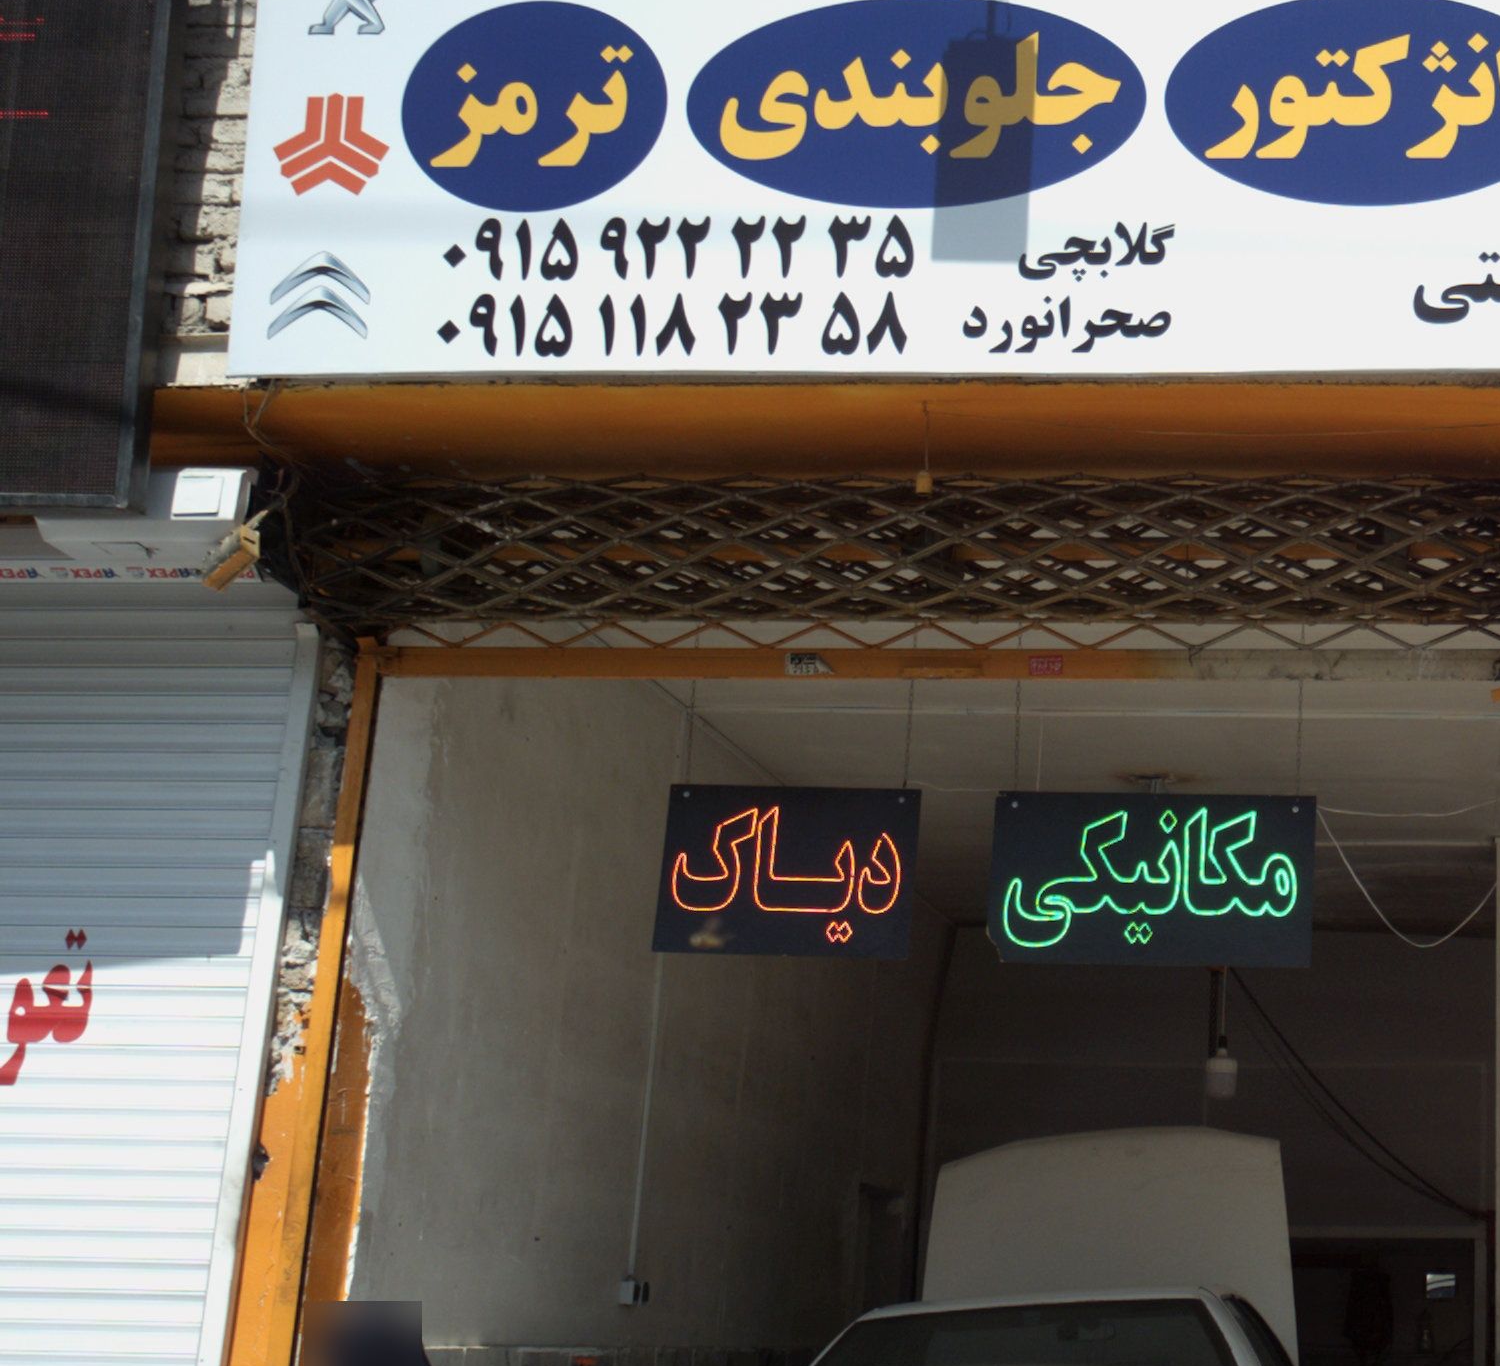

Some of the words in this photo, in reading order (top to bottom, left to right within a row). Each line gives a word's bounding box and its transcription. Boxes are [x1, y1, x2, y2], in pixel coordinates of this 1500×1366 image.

[431, 46, 633, 167] ترمز
[720, 32, 1122, 161] جلوبندی
[443, 218, 578, 280] ۰۹۱۵
[600, 216, 711, 280] ۹۲۲
[732, 215, 806, 278] ۲۲
[828, 214, 914, 278] ۳۵
[1019, 221, 1175, 282] گلابچی
[437, 292, 573, 357] ۰۹۱۵
[600, 293, 695, 356] ۱۱۸
[718, 292, 803, 355] ۲۳
[821, 291, 907, 355] ۵۸
[962, 296, 1172, 353] صحرانورد
[1002, 806, 1298, 948] مکانیکی
